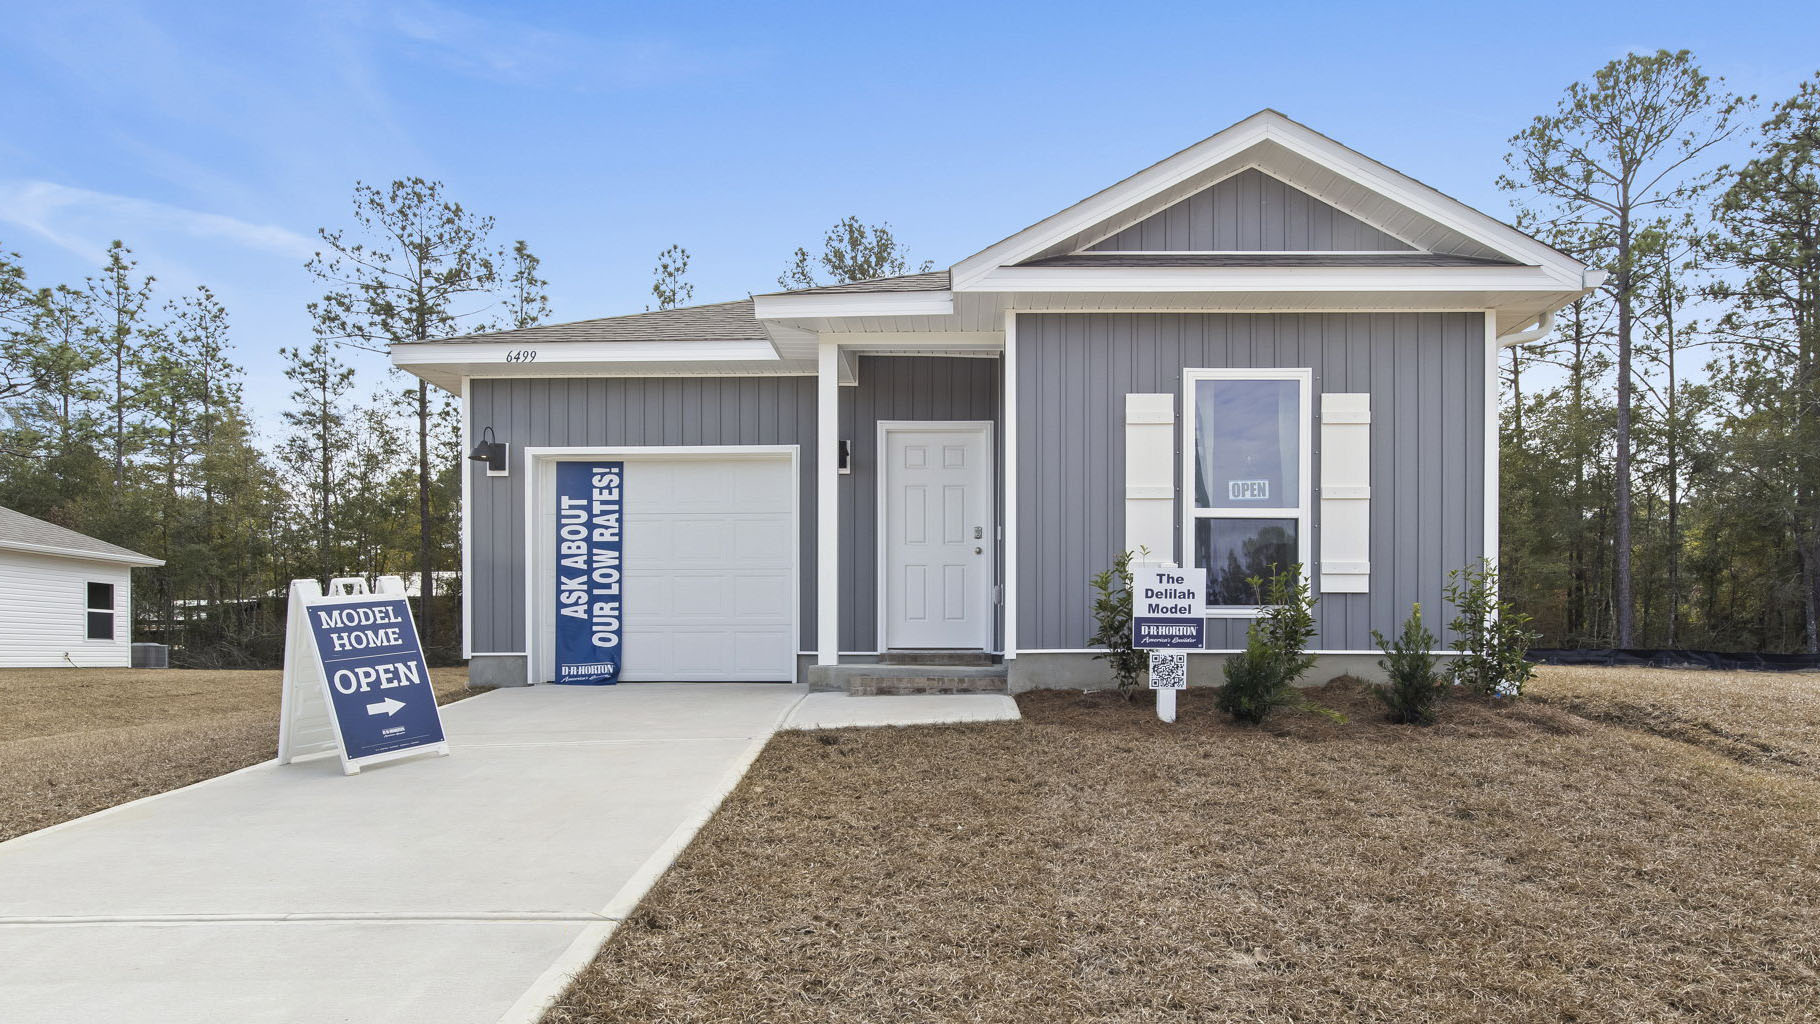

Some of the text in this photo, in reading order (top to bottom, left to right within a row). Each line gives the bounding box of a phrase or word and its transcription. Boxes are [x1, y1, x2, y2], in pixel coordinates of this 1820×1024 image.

[506, 350, 537, 363] 6499
[1231, 482, 1267, 498] OPEN
[592, 467, 620, 542] RATES!
[560, 496, 588, 619] ASK ABOUT
[592, 549, 620, 595] LOW
[1156, 573, 1184, 584] The
[1144, 588, 1196, 600] Delilah
[318, 606, 402, 629] MODEL
[1147, 603, 1192, 615] Model
[592, 602, 620, 648] OUR
[331, 628, 403, 651] HOME
[333, 661, 420, 695] OPEN
